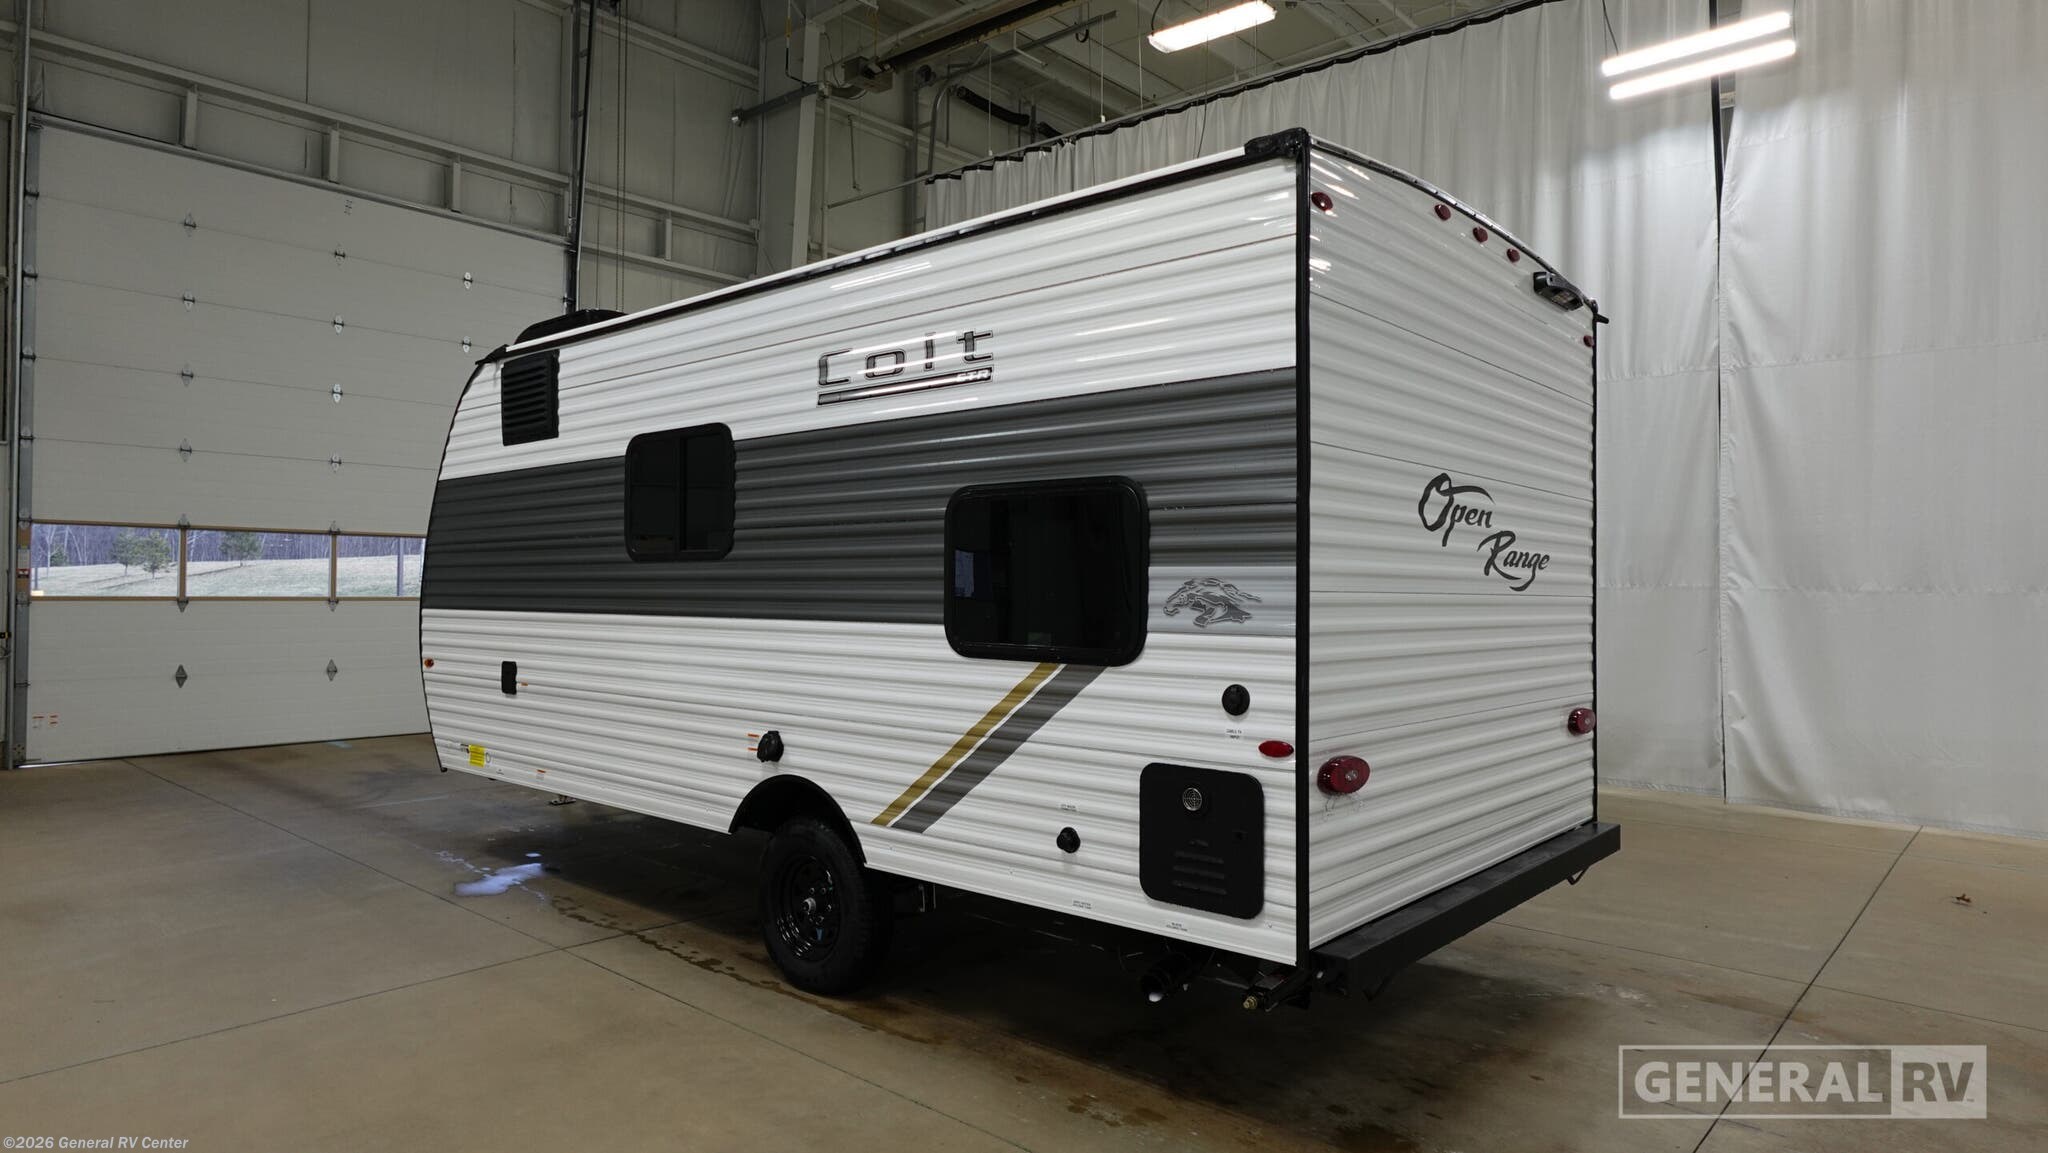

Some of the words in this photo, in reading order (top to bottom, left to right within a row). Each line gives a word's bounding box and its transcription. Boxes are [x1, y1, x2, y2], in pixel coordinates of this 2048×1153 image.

[818, 330, 993, 386] Colt
[1418, 472, 1496, 547] Open
[1476, 530, 1550, 591] Range
